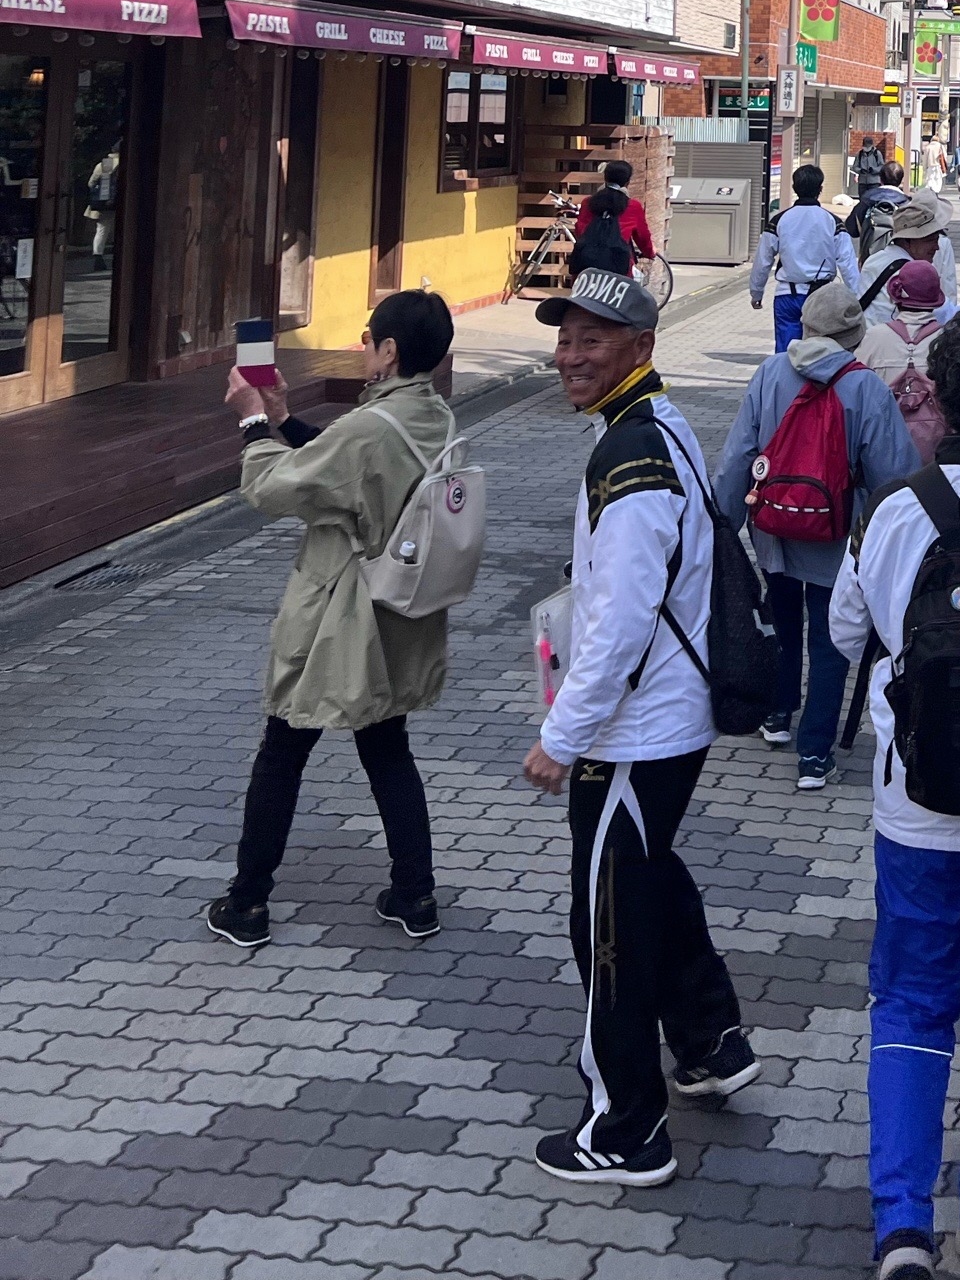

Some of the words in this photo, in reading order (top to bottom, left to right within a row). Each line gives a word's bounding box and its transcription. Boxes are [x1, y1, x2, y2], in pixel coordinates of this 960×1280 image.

[120, 0, 168, 24] PIZZA
[246, 13, 291, 34] PASTA
[315, 21, 348, 40] GRILL
[369, 27, 406, 46] CHEESE
[423, 35, 449, 51] PIZZA
[486, 43, 508, 59] PASTA
[522, 48, 541, 62] GRILL
[552, 51, 575, 65] CHEESE
[583, 56, 599, 68] PIZZA
[621, 60, 637, 72] PASTA
[784, 72, 794, 110] 天神通り
